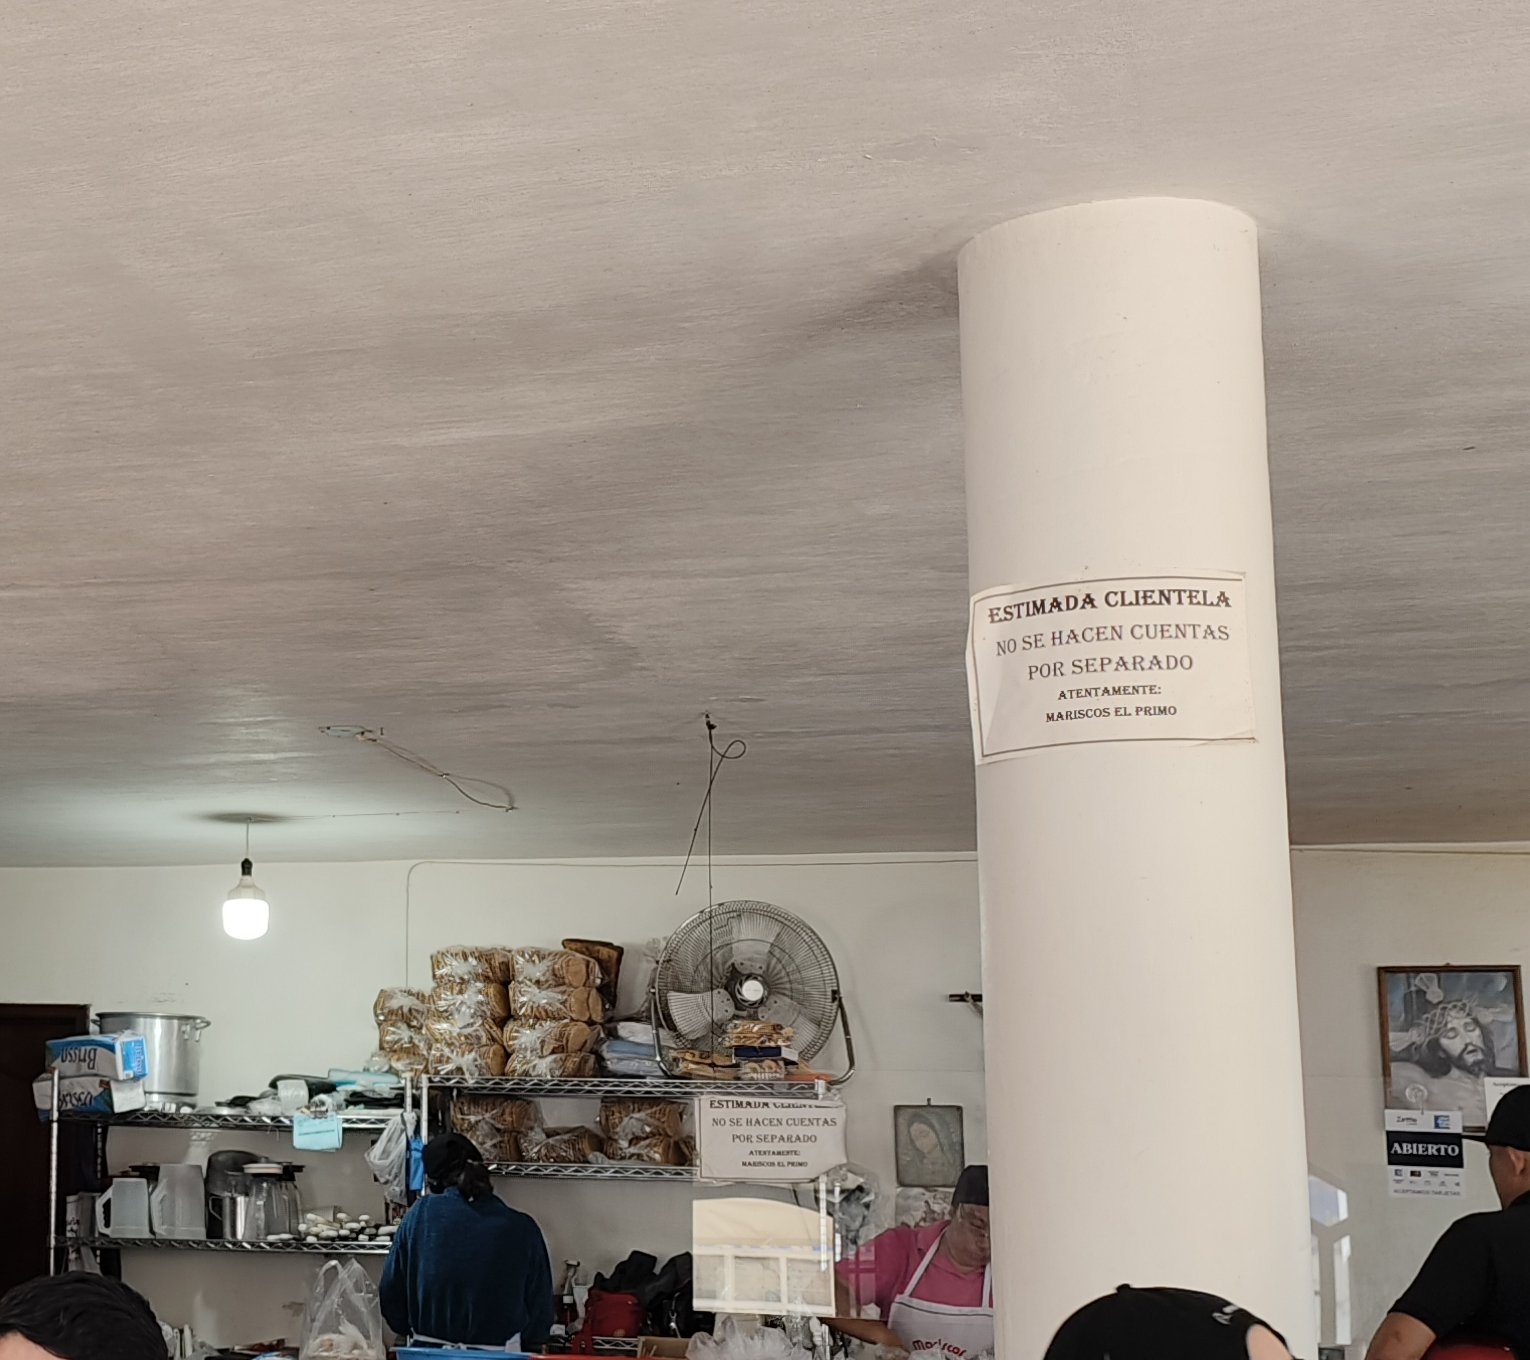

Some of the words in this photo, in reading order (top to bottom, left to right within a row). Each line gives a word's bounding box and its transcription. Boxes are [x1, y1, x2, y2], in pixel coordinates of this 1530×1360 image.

[988, 593, 1098, 624] ESTIMADA
[1104, 589, 1232, 608] CLIENTELA
[996, 638, 1017, 657] NO
[1021, 633, 1046, 651] SE
[1051, 625, 1124, 646] HACEN
[1129, 623, 1230, 641] CUENTAS
[1028, 661, 1066, 681] POR
[1071, 654, 1194, 675] SEPARADO
[1057, 684, 1162, 701] ATENTAMENTE:
[1045, 707, 1111, 723] MARISCOS
[1114, 707, 1132, 717] EL
[1135, 705, 1178, 717] PRIMO
[58, 1091, 93, 1108] rissa
[709, 1099, 770, 1109] ESTIMADA
[711, 1117, 726, 1127] NO
[729, 1117, 743, 1127] SE
[745, 1117, 783, 1127] HACEN
[785, 1117, 837, 1127] CUENTAS
[731, 1133, 753, 1143] POR
[756, 1133, 818, 1143] SEPARADO
[1390, 1142, 1459, 1157] ABIERTO
